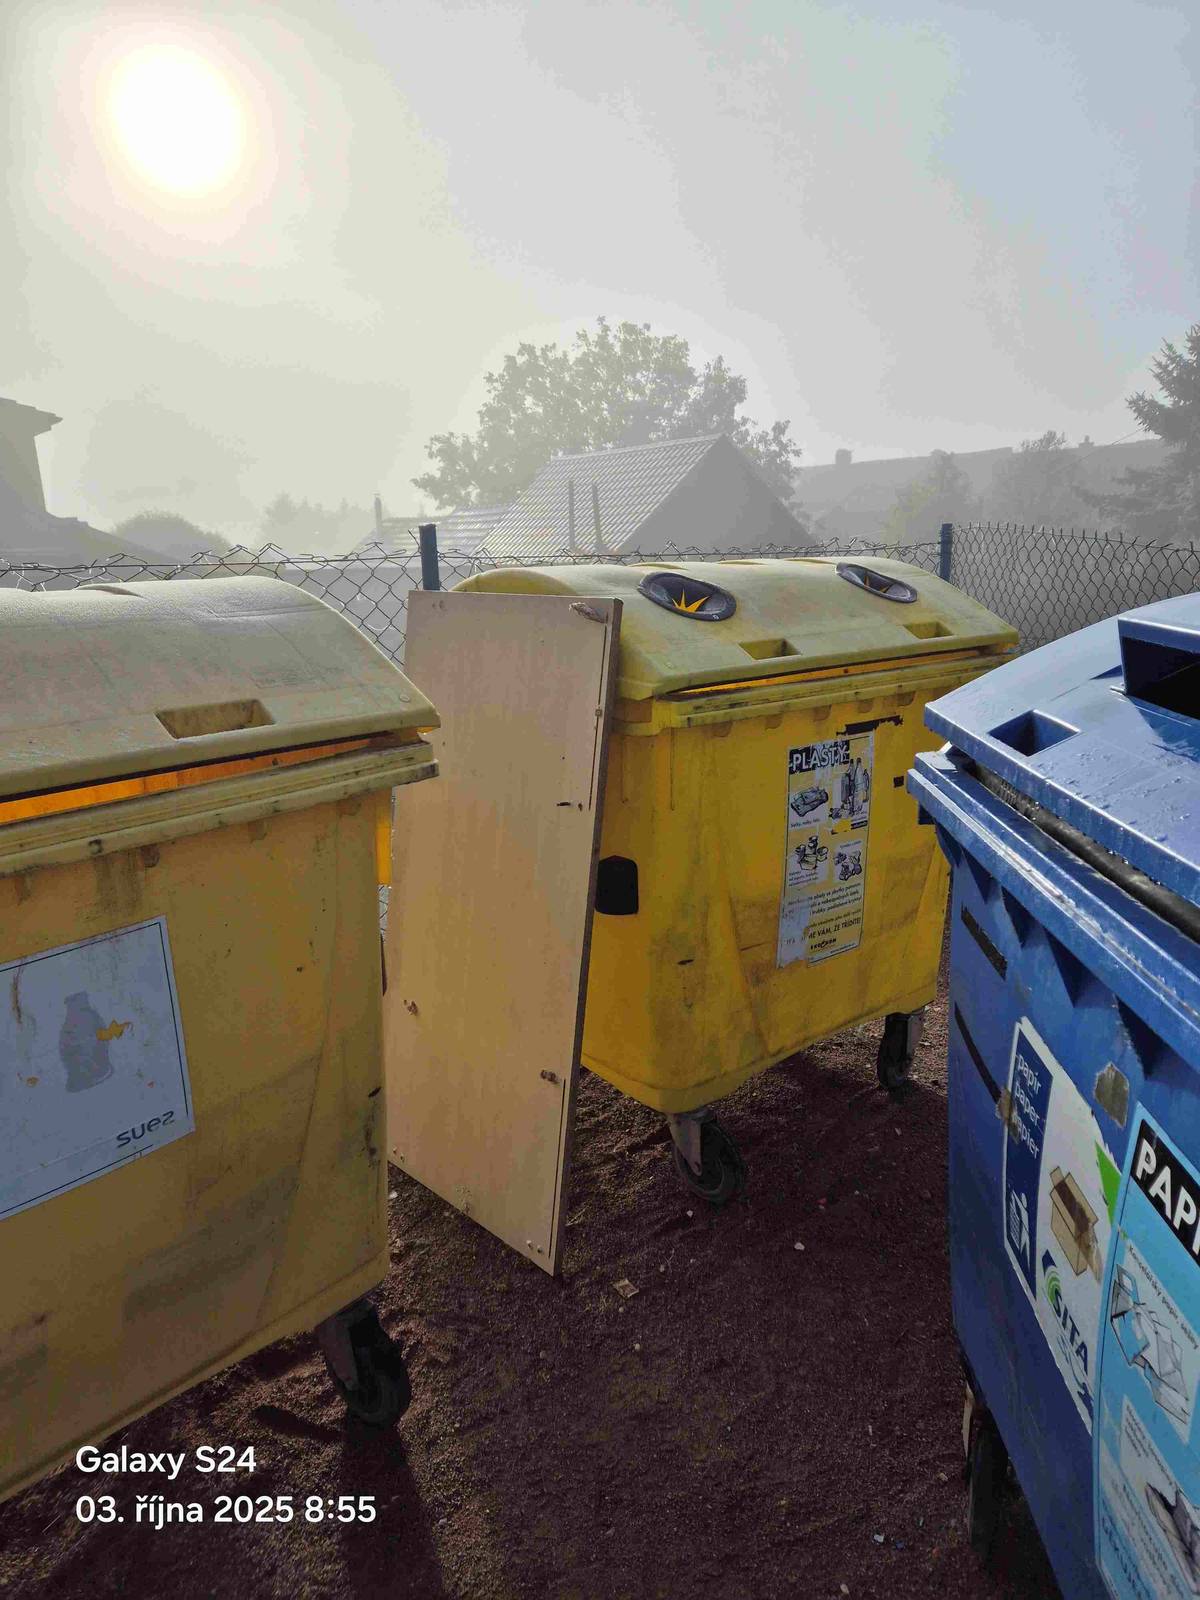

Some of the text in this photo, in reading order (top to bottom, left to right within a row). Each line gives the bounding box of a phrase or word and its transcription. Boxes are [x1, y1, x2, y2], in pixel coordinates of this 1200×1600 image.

[792, 746, 847, 772] PLASTY
[116, 1110, 175, 1148] suez
[1053, 1287, 1089, 1376] SITA
